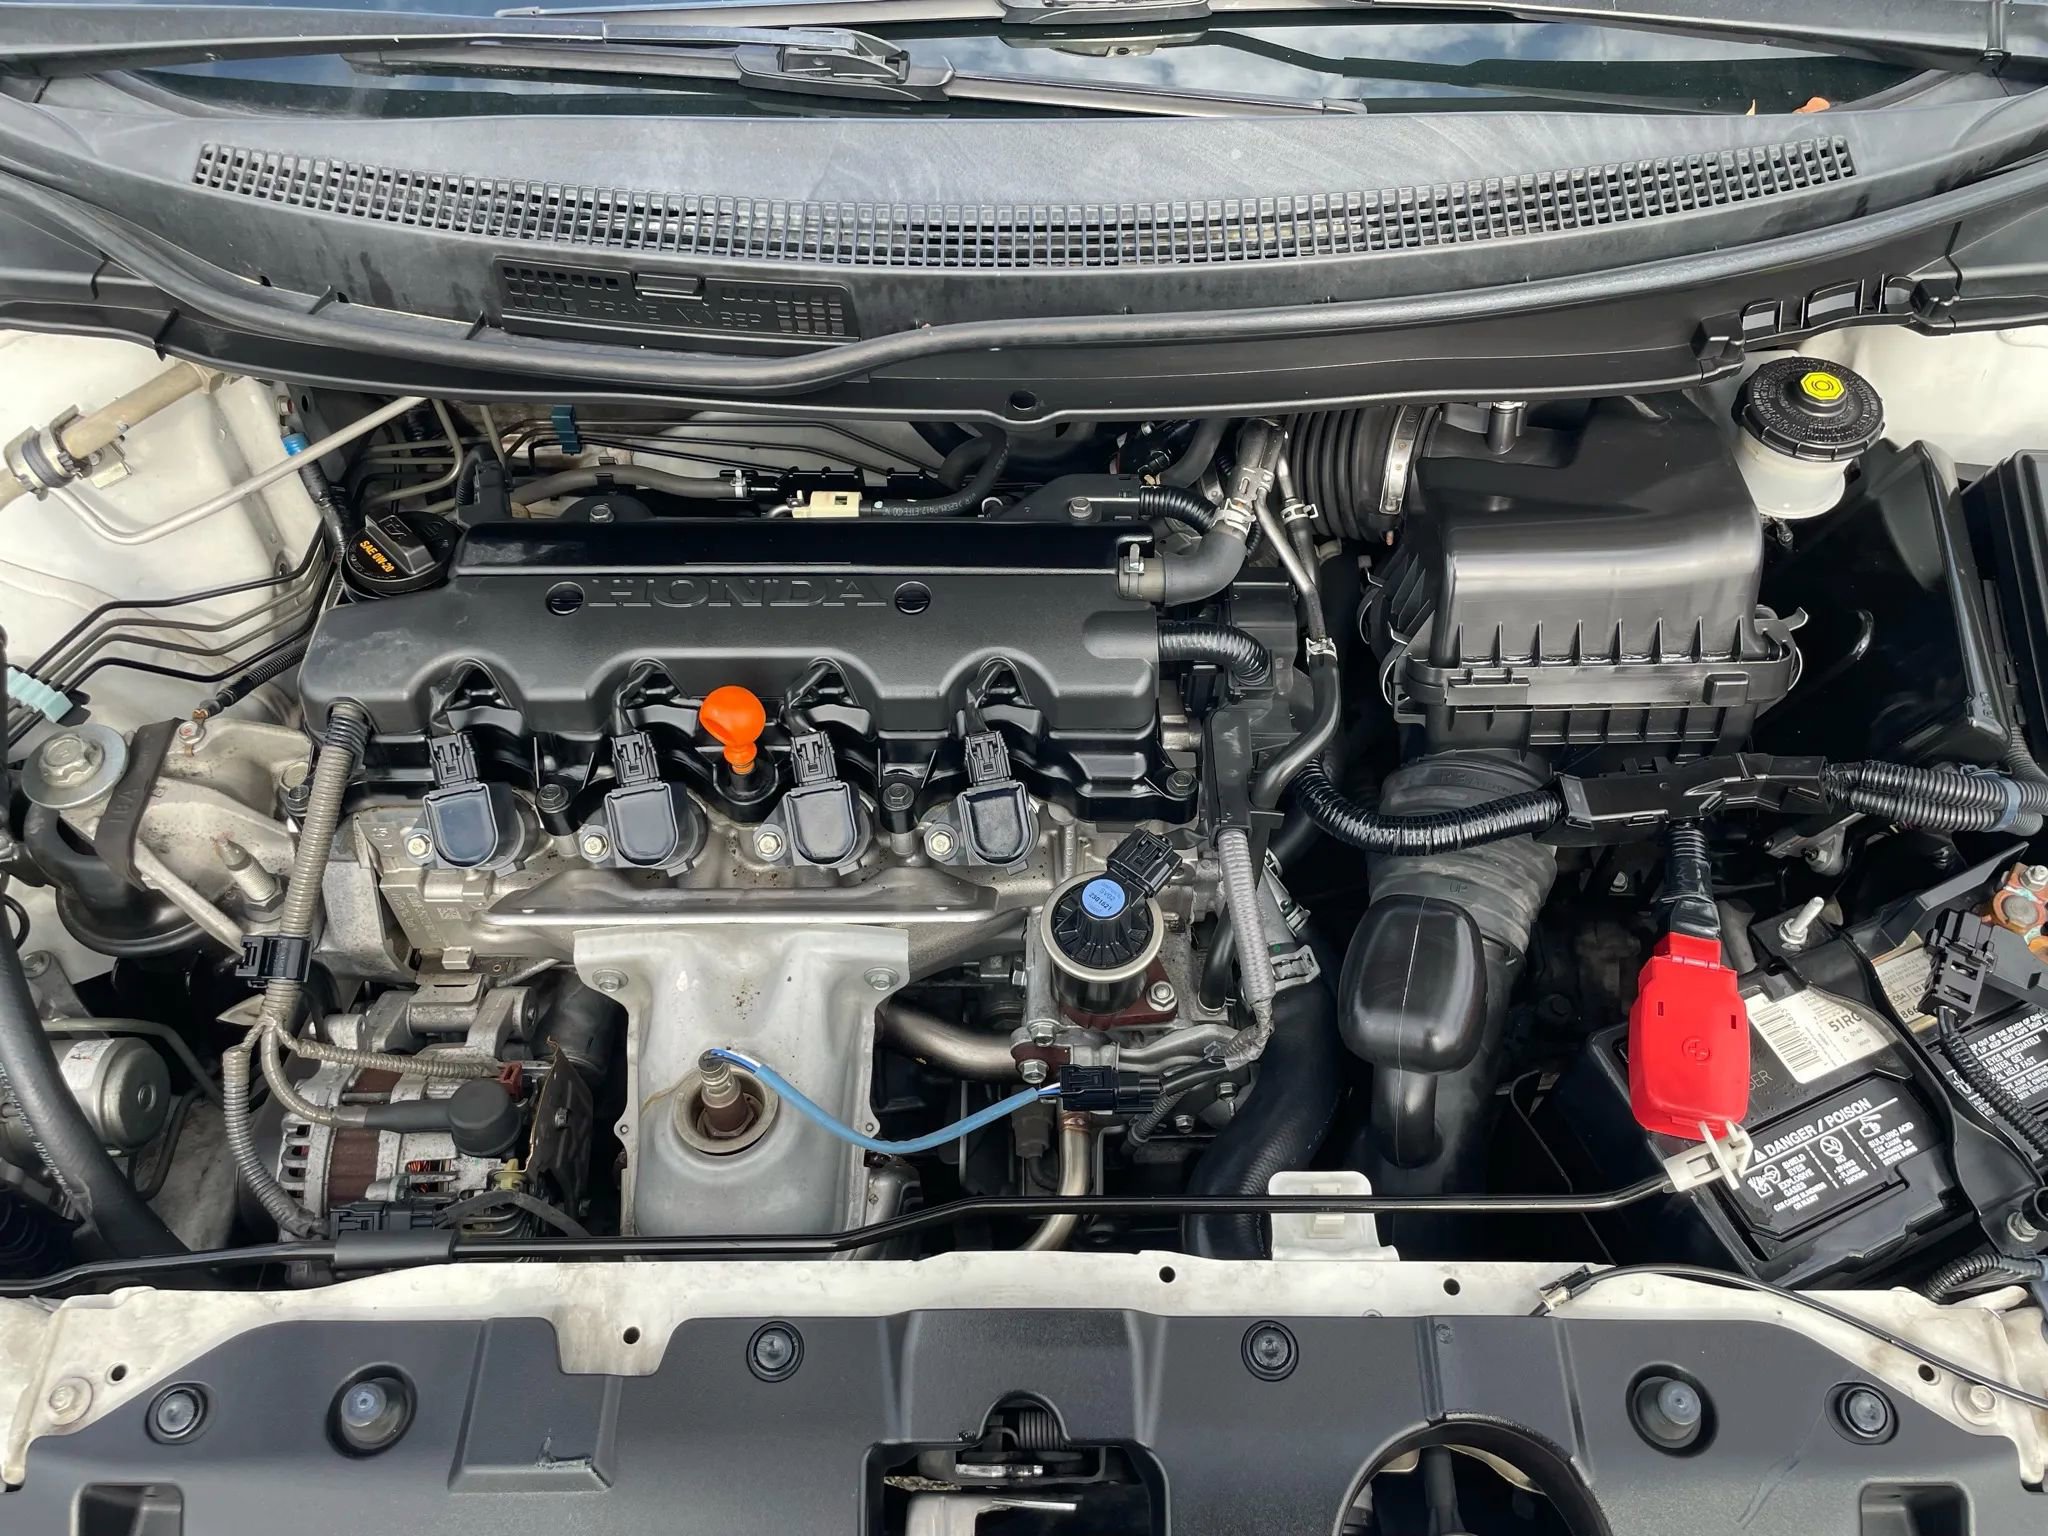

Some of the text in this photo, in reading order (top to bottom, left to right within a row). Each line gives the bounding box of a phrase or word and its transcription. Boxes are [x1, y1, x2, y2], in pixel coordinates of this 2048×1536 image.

[588, 300, 762, 328] FRAME NUMBER
[360, 540, 378, 556] SAE
[372, 552, 395, 573] 0W-20
[588, 578, 888, 608] HONDA
[1995, 1029, 2007, 1038] THE
[1985, 1053, 2004, 1066] EYES
[2001, 1034, 2042, 1059] IMMEDIATELY
[2010, 1052, 2025, 1064] GET
[2003, 1064, 2021, 1077] HELP
[2020, 1056, 2037, 1069] FAST
[1763, 1125, 1818, 1157] DANGER
[1823, 1097, 1873, 1128] POISON
[1867, 1121, 1914, 1148] SULFURIC ACID
[1781, 1153, 1807, 1169] SHIELD
[1786, 1163, 1806, 1177] EYES
[1834, 1154, 1847, 1164] NO
[1777, 1168, 1815, 1191] EXPLOSIVE
[1783, 1181, 1807, 1197] GASES
